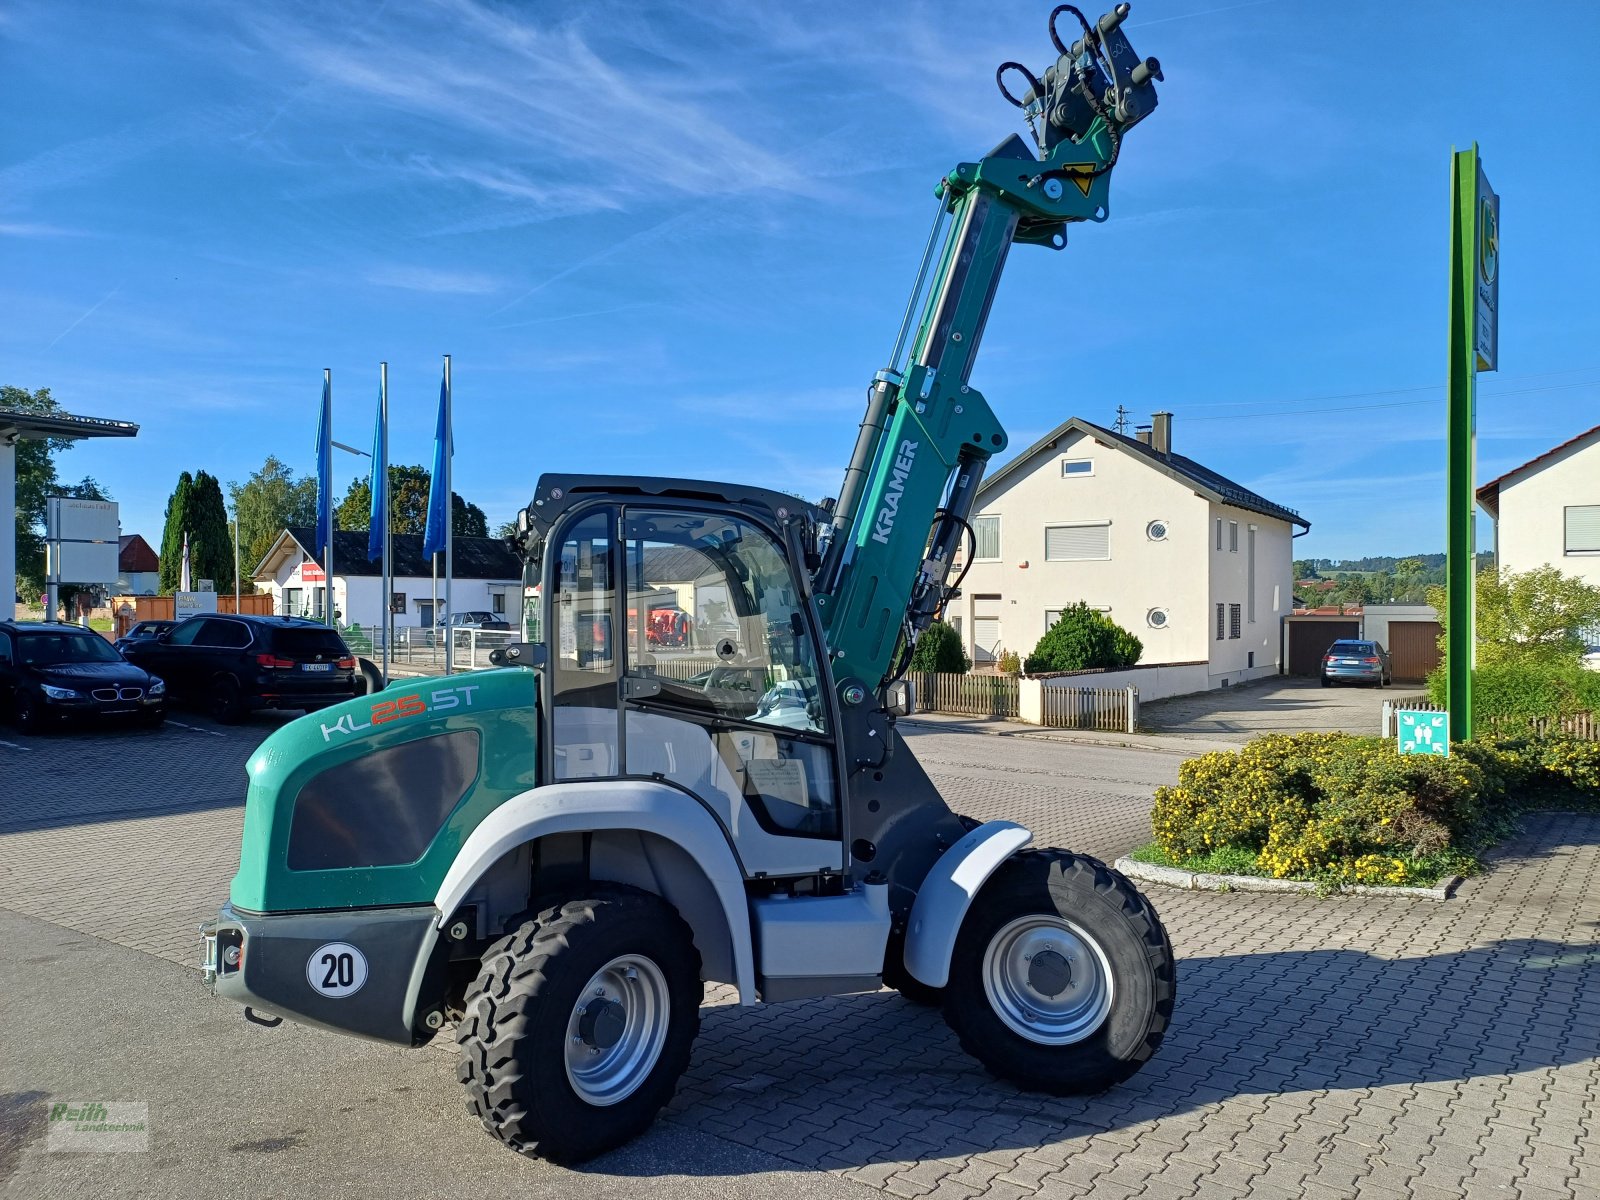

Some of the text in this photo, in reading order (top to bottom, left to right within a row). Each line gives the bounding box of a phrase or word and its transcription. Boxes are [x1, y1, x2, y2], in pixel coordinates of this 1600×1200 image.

[872, 439, 919, 545] KRAMER
[320, 685, 479, 742] KL25.5T
[321, 953, 354, 988] 20
